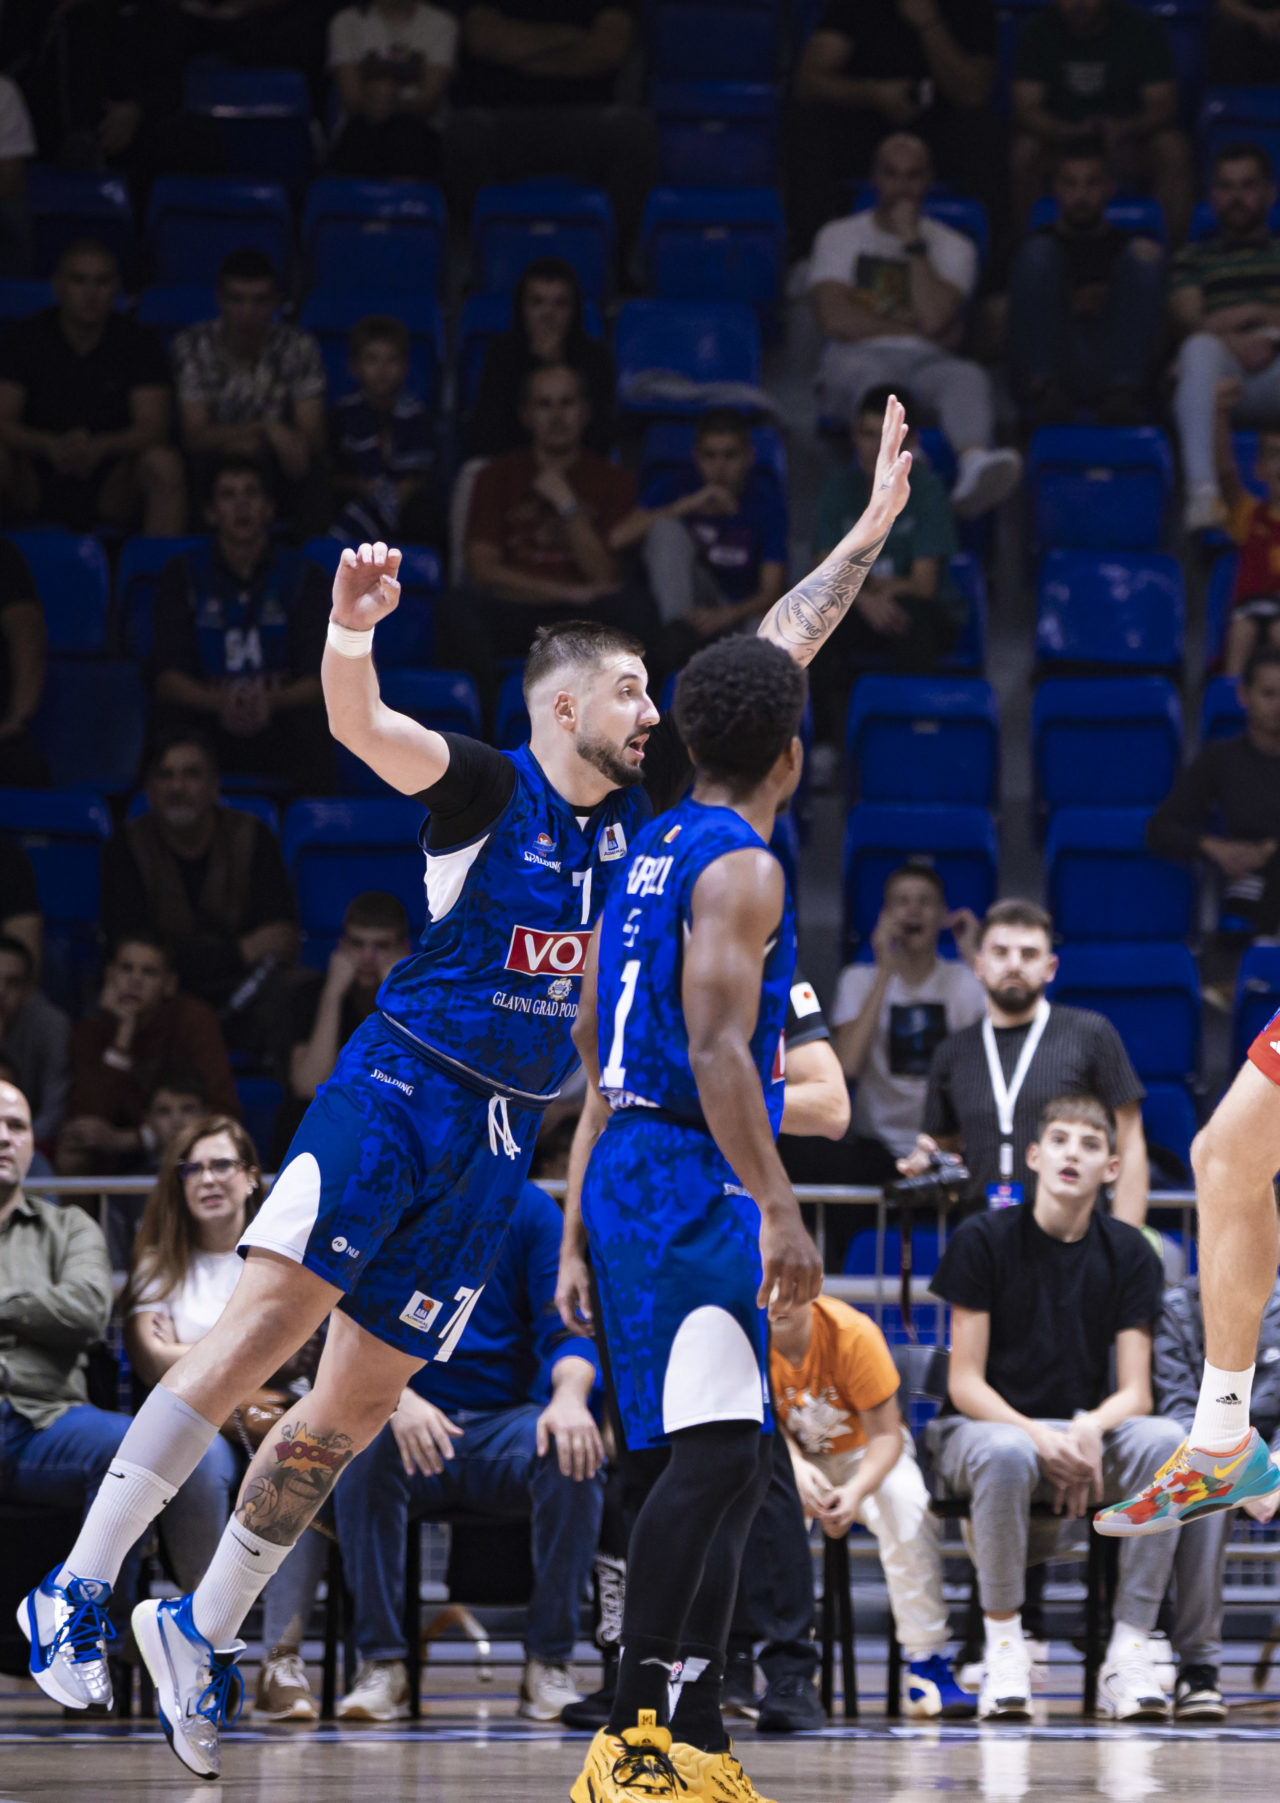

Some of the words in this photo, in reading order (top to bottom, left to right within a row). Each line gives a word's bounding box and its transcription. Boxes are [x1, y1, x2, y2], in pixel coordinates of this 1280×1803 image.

[524, 851, 561, 873] SPALDING
[525, 933, 591, 972] VO
[492, 991, 532, 1013] GLAVNI
[532, 1000, 559, 1016] GRAD
[603, 959, 641, 1089] 1
[370, 1068, 414, 1096] SPALDING
[433, 1283, 486, 1363] 7
